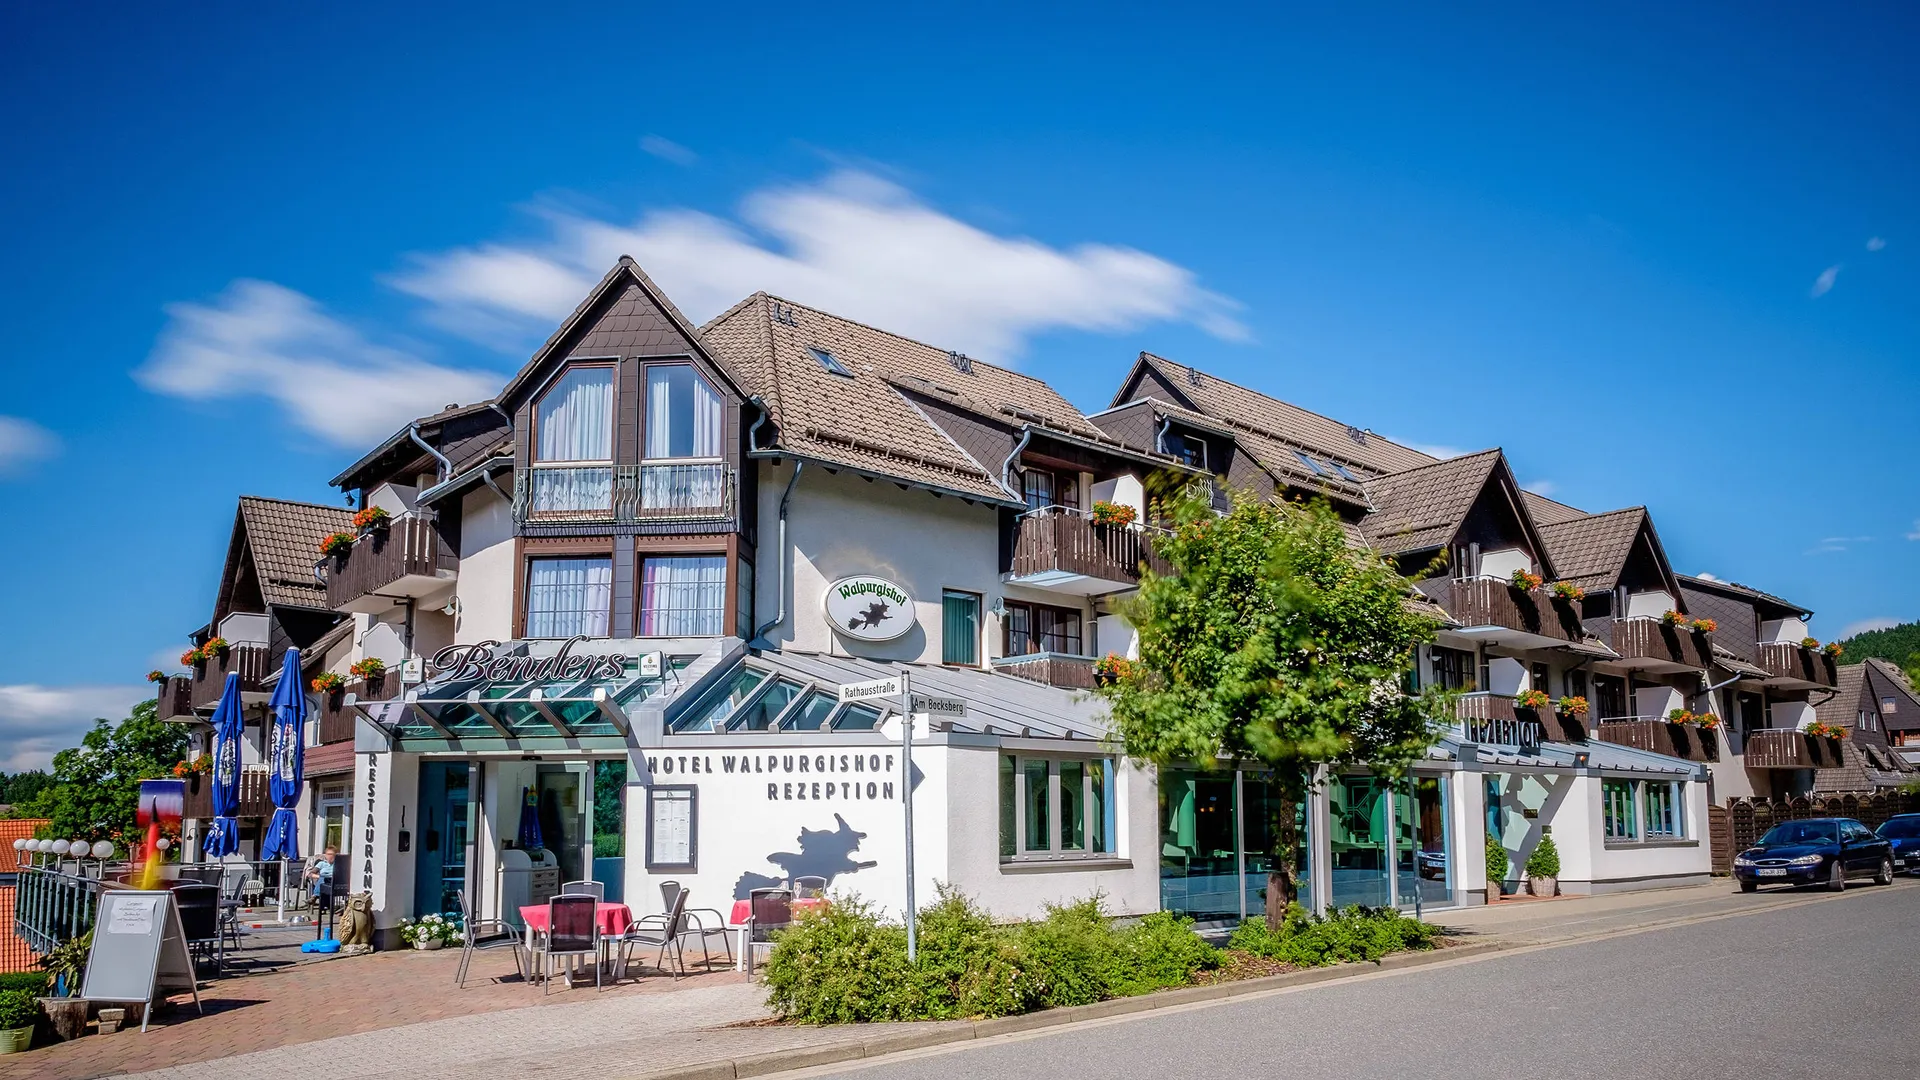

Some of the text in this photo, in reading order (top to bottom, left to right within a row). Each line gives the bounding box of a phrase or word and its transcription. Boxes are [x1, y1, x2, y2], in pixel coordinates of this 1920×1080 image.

[838, 581, 907, 606] Walpurgishof
[432, 634, 627, 684] Benders
[845, 682, 896, 698] Rathausstraße
[914, 699, 964, 715] Am Bocksberg
[648, 754, 894, 774] HOTEL WALPURGISHOF
[767, 781, 894, 800] REZEPTION
[363, 753, 377, 894] RESTAURAN
